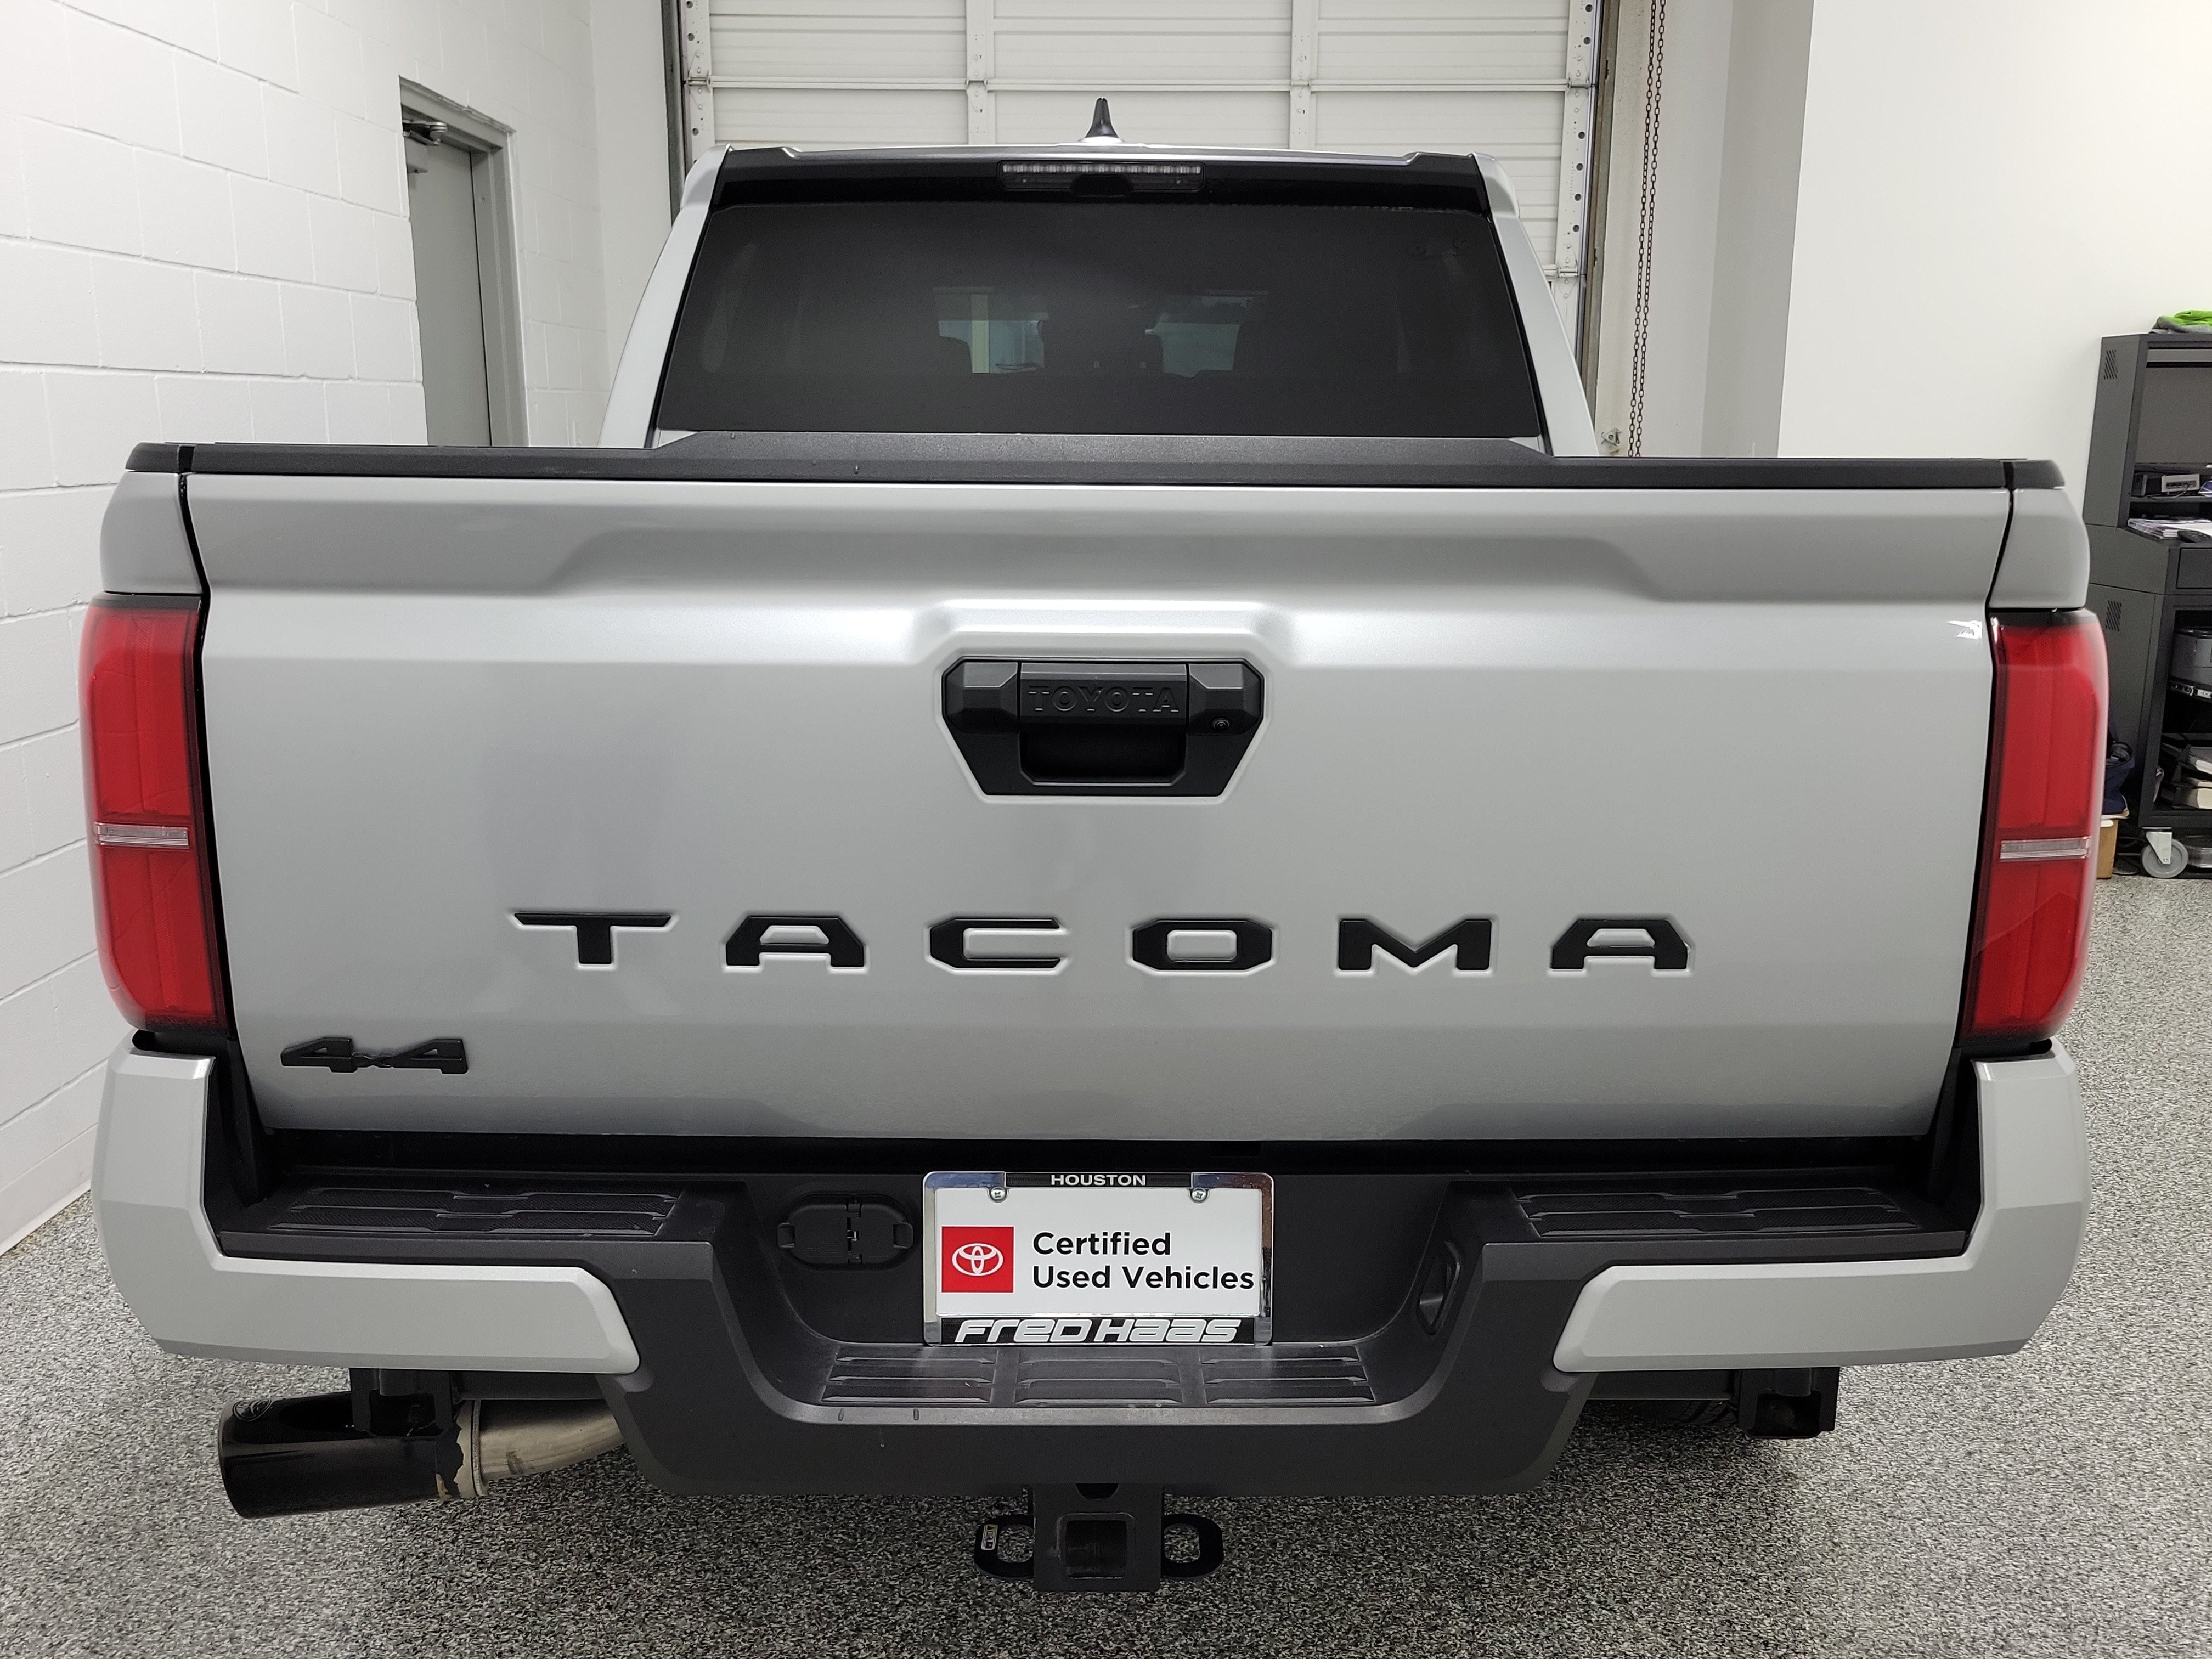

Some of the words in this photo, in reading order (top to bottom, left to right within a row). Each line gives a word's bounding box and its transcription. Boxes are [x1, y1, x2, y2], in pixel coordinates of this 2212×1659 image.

[1028, 685, 1180, 713] TOYOTA
[514, 912, 1690, 972] TACOMA
[1050, 1174, 1146, 1186] HOUSTON
[1032, 1231, 1171, 1256] Certified
[1032, 1265, 1111, 1289] Used
[1121, 1265, 1255, 1290] Vehicles
